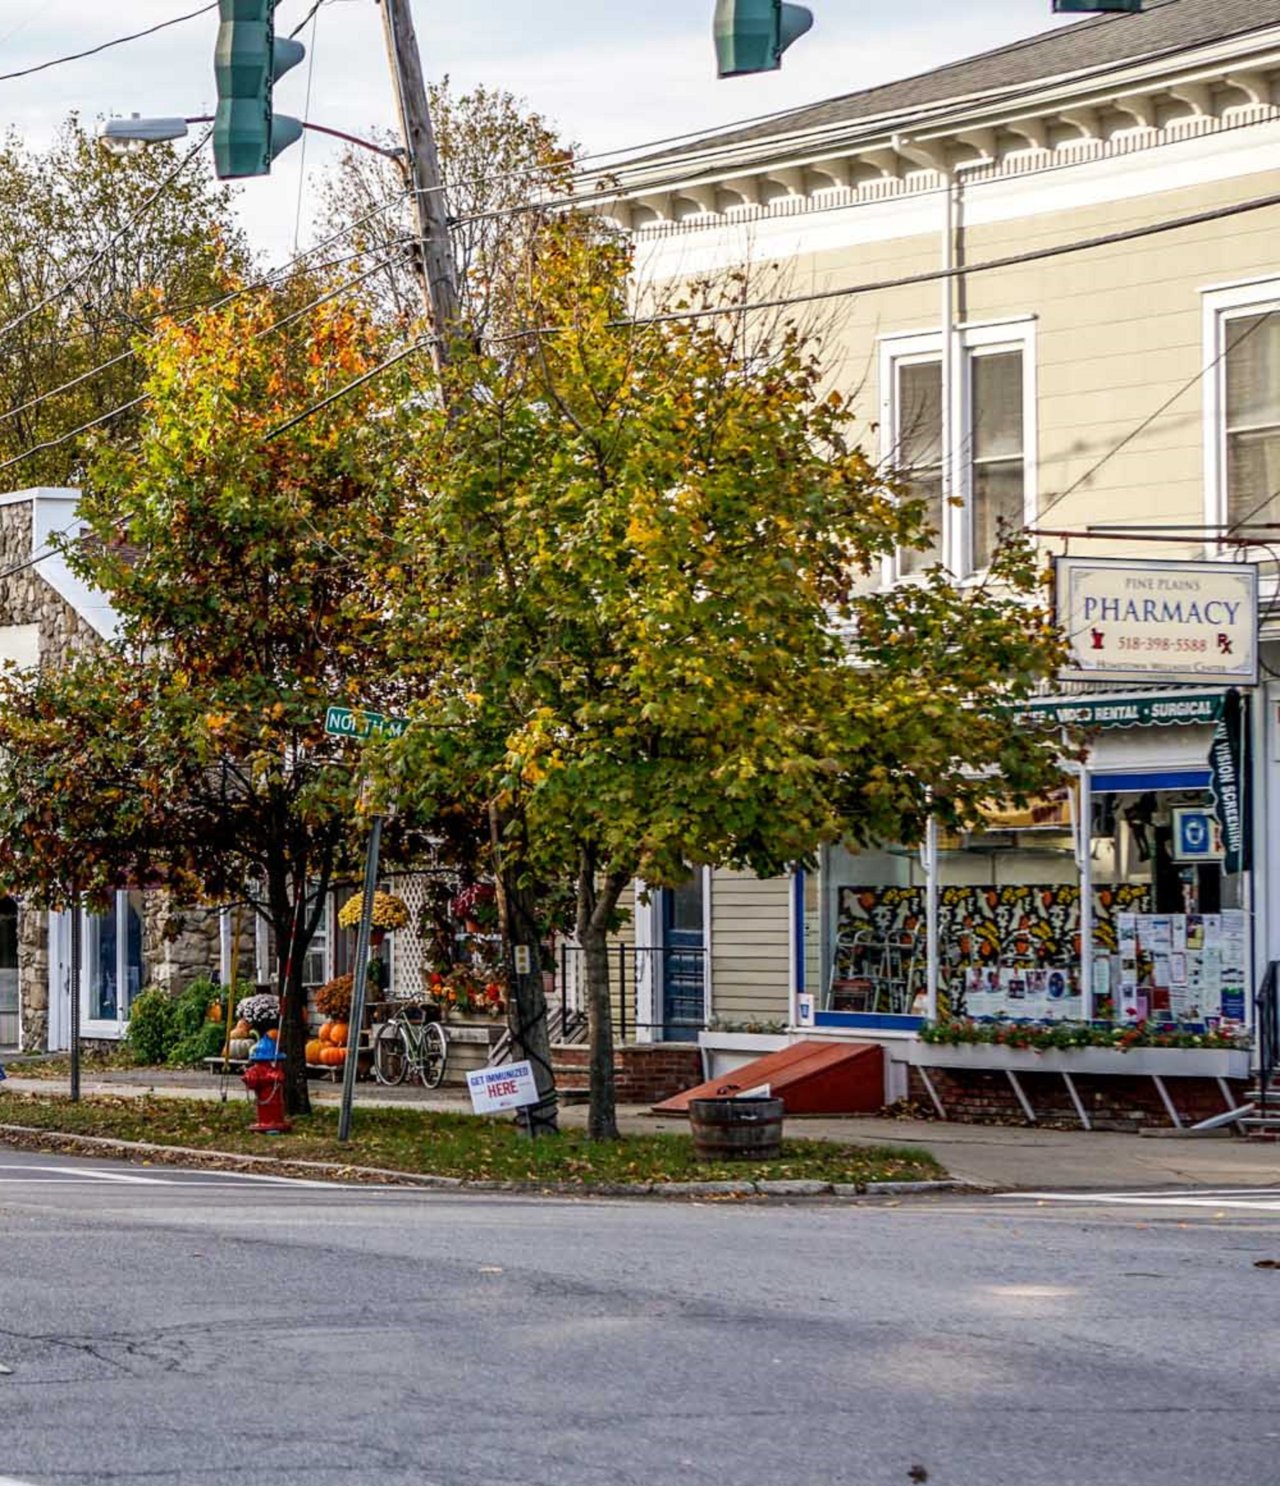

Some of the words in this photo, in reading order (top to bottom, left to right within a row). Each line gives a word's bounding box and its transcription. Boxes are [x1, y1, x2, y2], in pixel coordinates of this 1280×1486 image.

[1125, 578, 1154, 590] PINE
[1158, 579, 1200, 591] PLAINS
[1084, 597, 1240, 625] PHARMACY
[1118, 636, 1207, 653] 518-398-5588
[1055, 707, 1092, 723] VIDEO
[1094, 703, 1139, 721] RENTAL
[1151, 700, 1212, 718] SURGICAL
[1215, 742, 1236, 783] VISION
[1221, 785, 1241, 852] SCREENING
[470, 1076, 484, 1086] GET
[485, 1066, 529, 1082] IMMUNIZED
[487, 1080, 519, 1098] HERE
